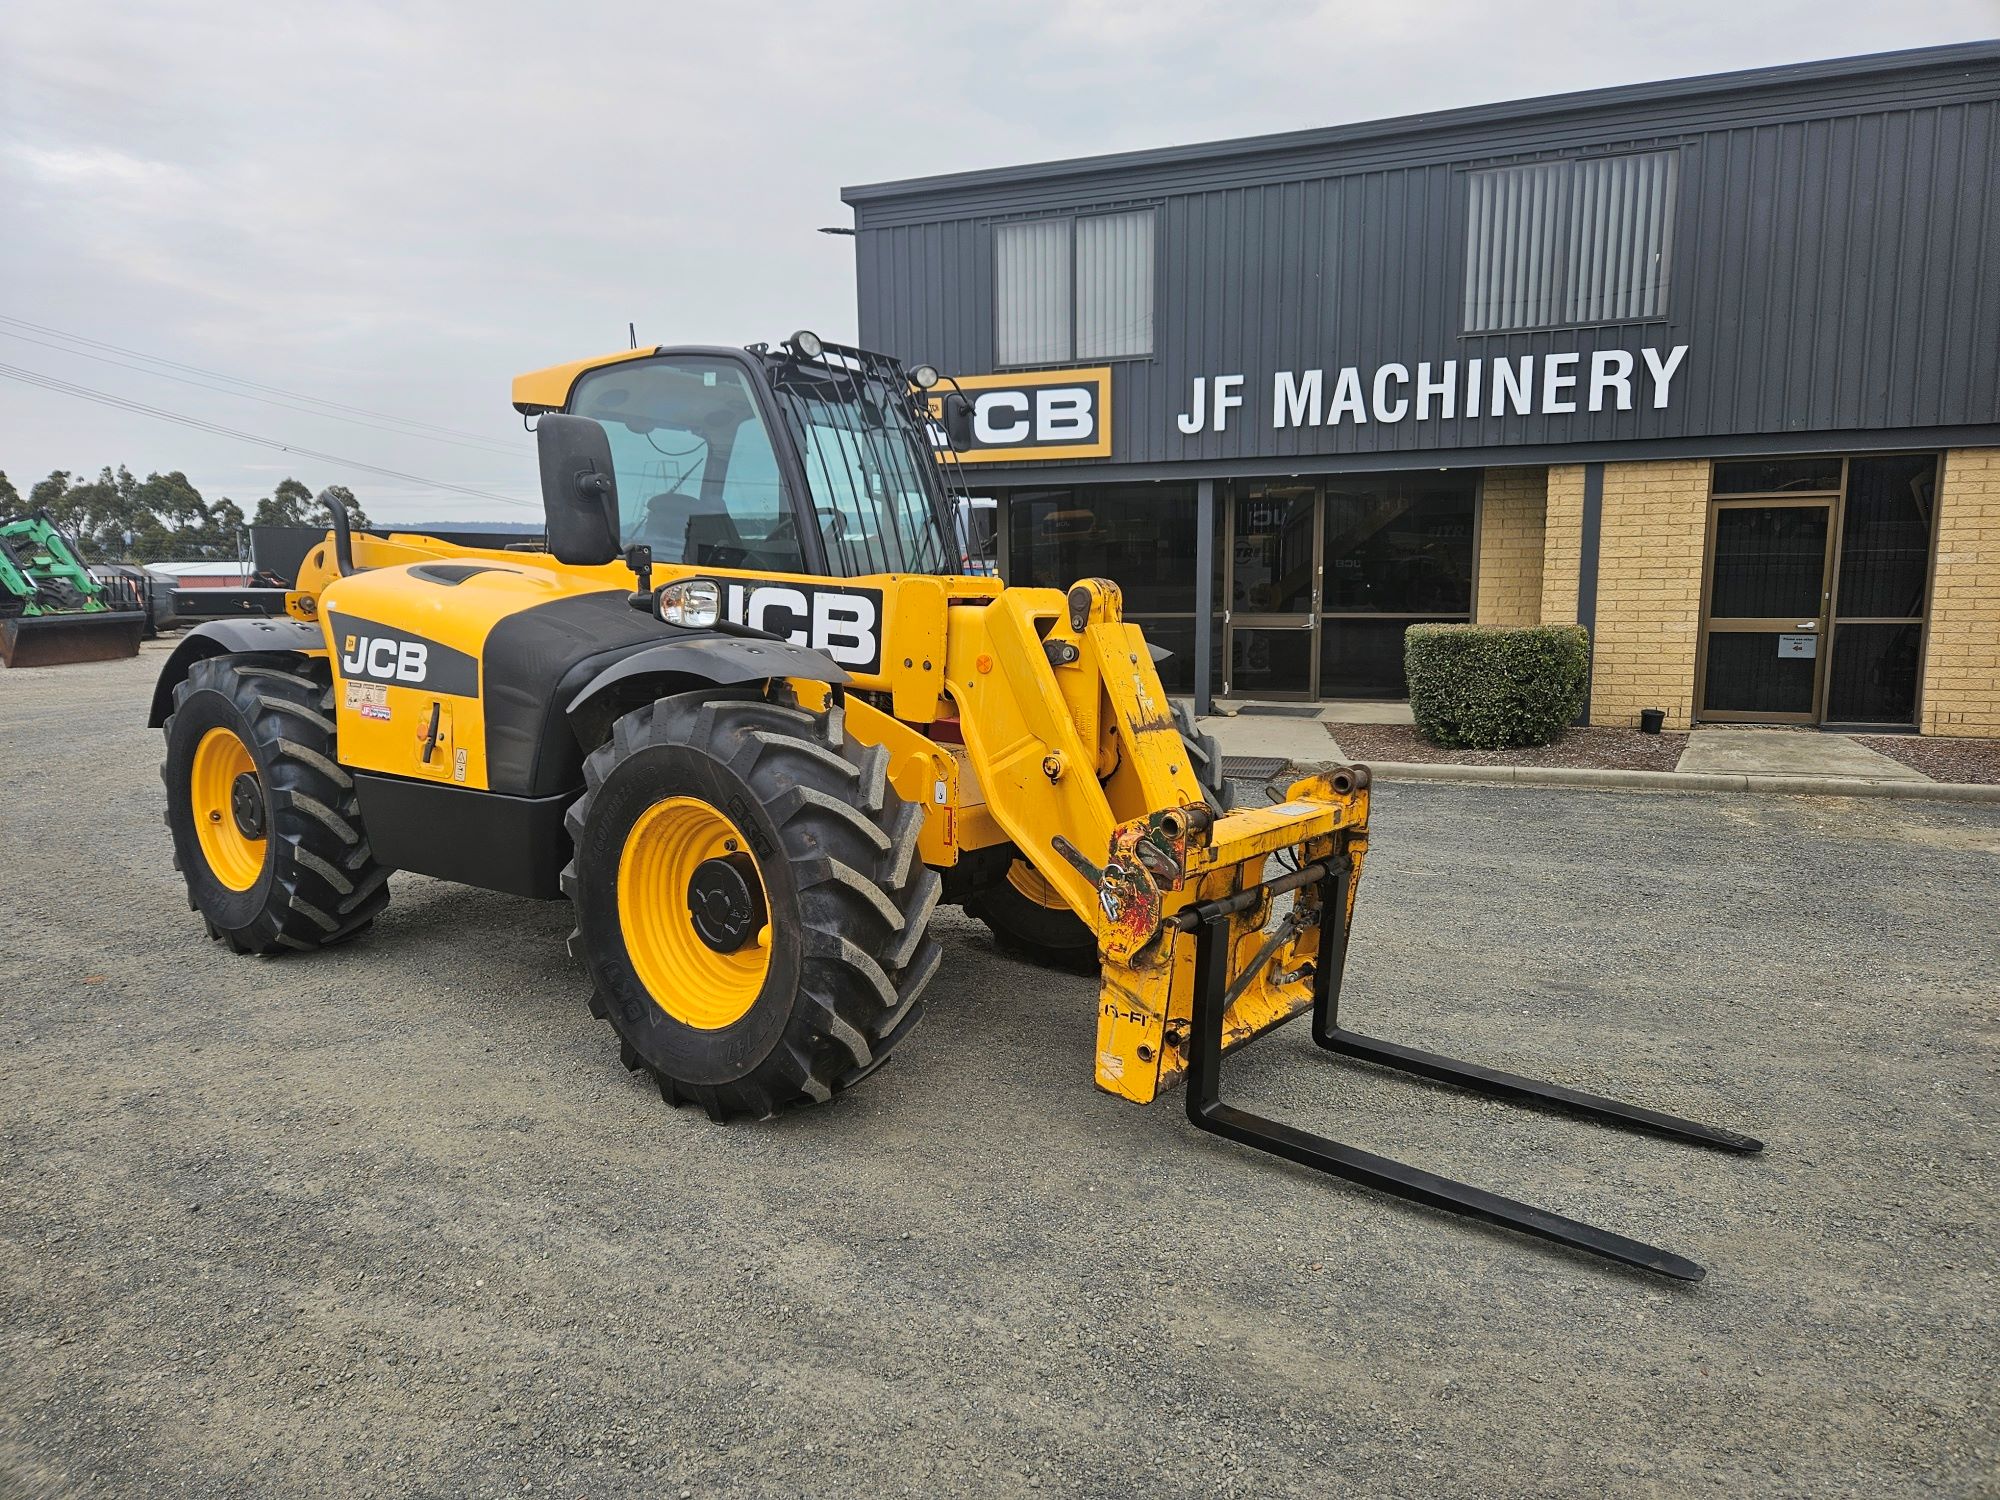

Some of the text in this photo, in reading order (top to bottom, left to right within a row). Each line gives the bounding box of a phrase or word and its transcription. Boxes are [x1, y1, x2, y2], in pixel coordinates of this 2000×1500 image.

[1177, 345, 1689, 434] JF MACHINERY
[343, 636, 428, 683] JCB
